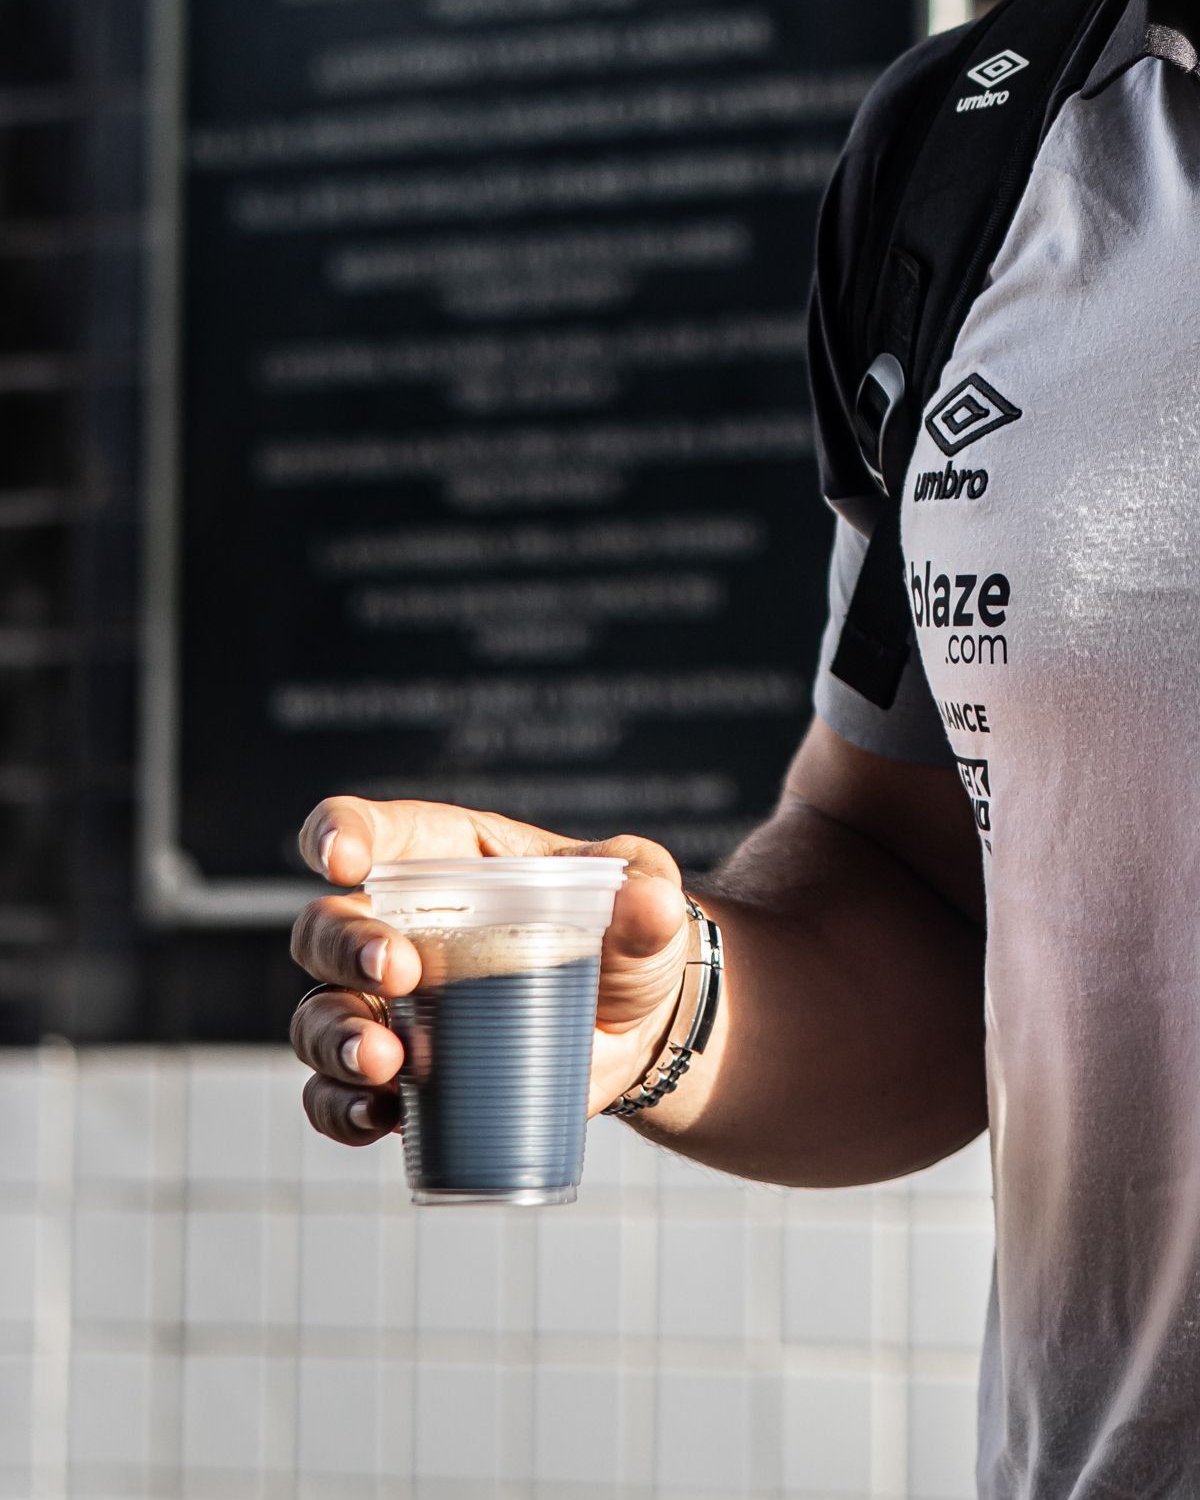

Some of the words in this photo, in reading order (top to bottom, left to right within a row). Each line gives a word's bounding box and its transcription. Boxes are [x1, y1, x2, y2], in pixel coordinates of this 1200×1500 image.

[956, 90, 1009, 112] umbro
[914, 461, 988, 502] umbro
[911, 561, 1010, 627] blaze
[945, 634, 1007, 665] .com
